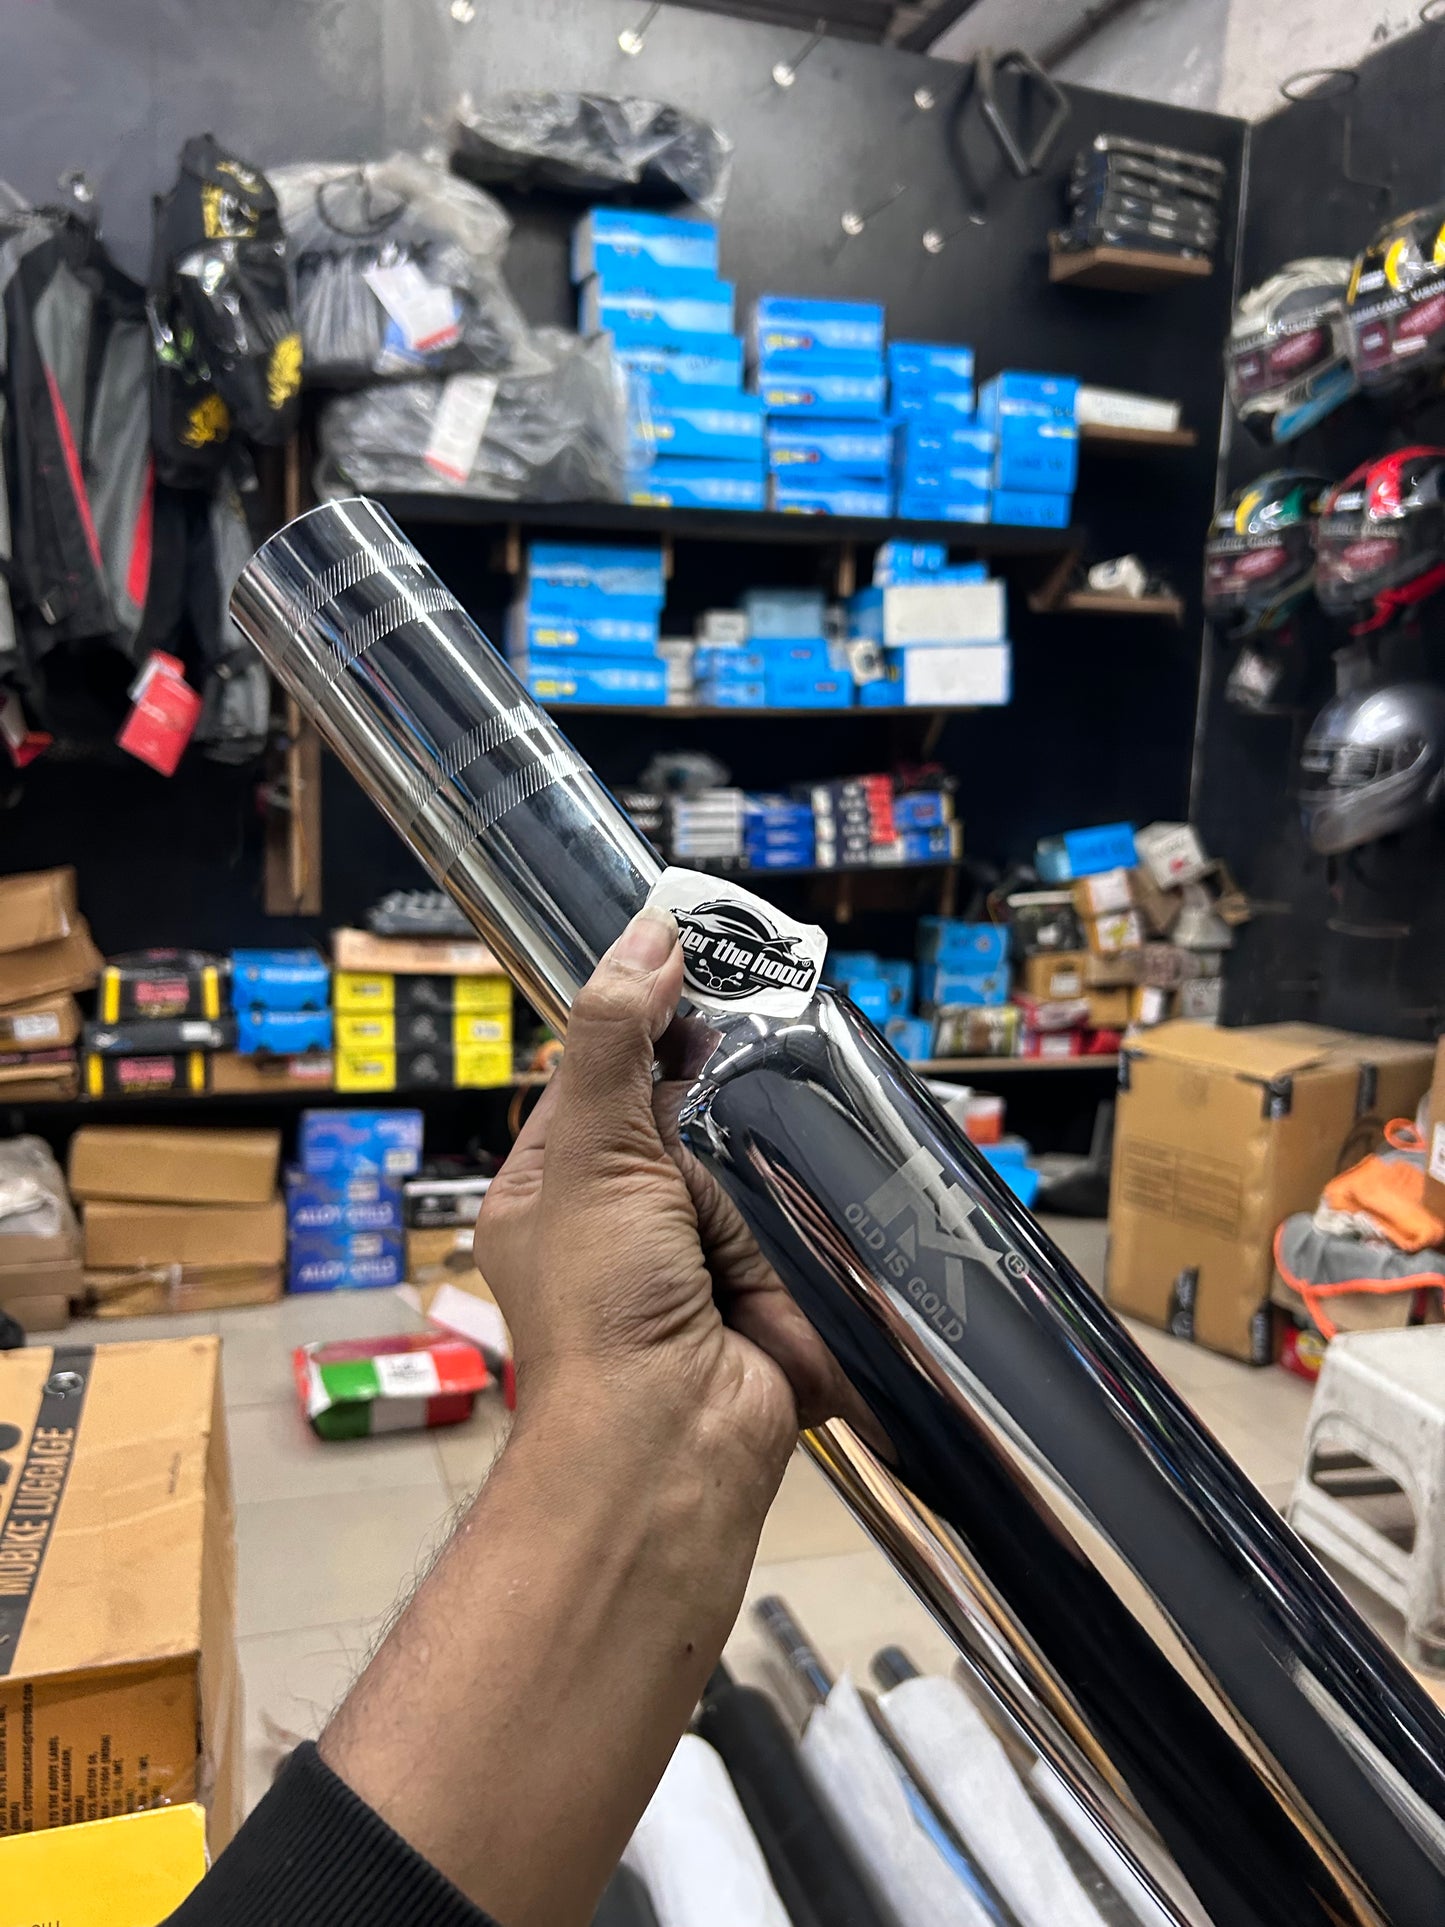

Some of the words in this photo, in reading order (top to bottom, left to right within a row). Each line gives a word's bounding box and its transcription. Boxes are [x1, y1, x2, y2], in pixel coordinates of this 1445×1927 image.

[712, 938, 753, 969] the
[750, 952, 816, 990] hood
[844, 1202, 886, 1250] OLD
[883, 1247, 910, 1278] IS
[907, 1276, 964, 1343] GOLD
[13, 1425, 74, 1516] LUGGAGE
